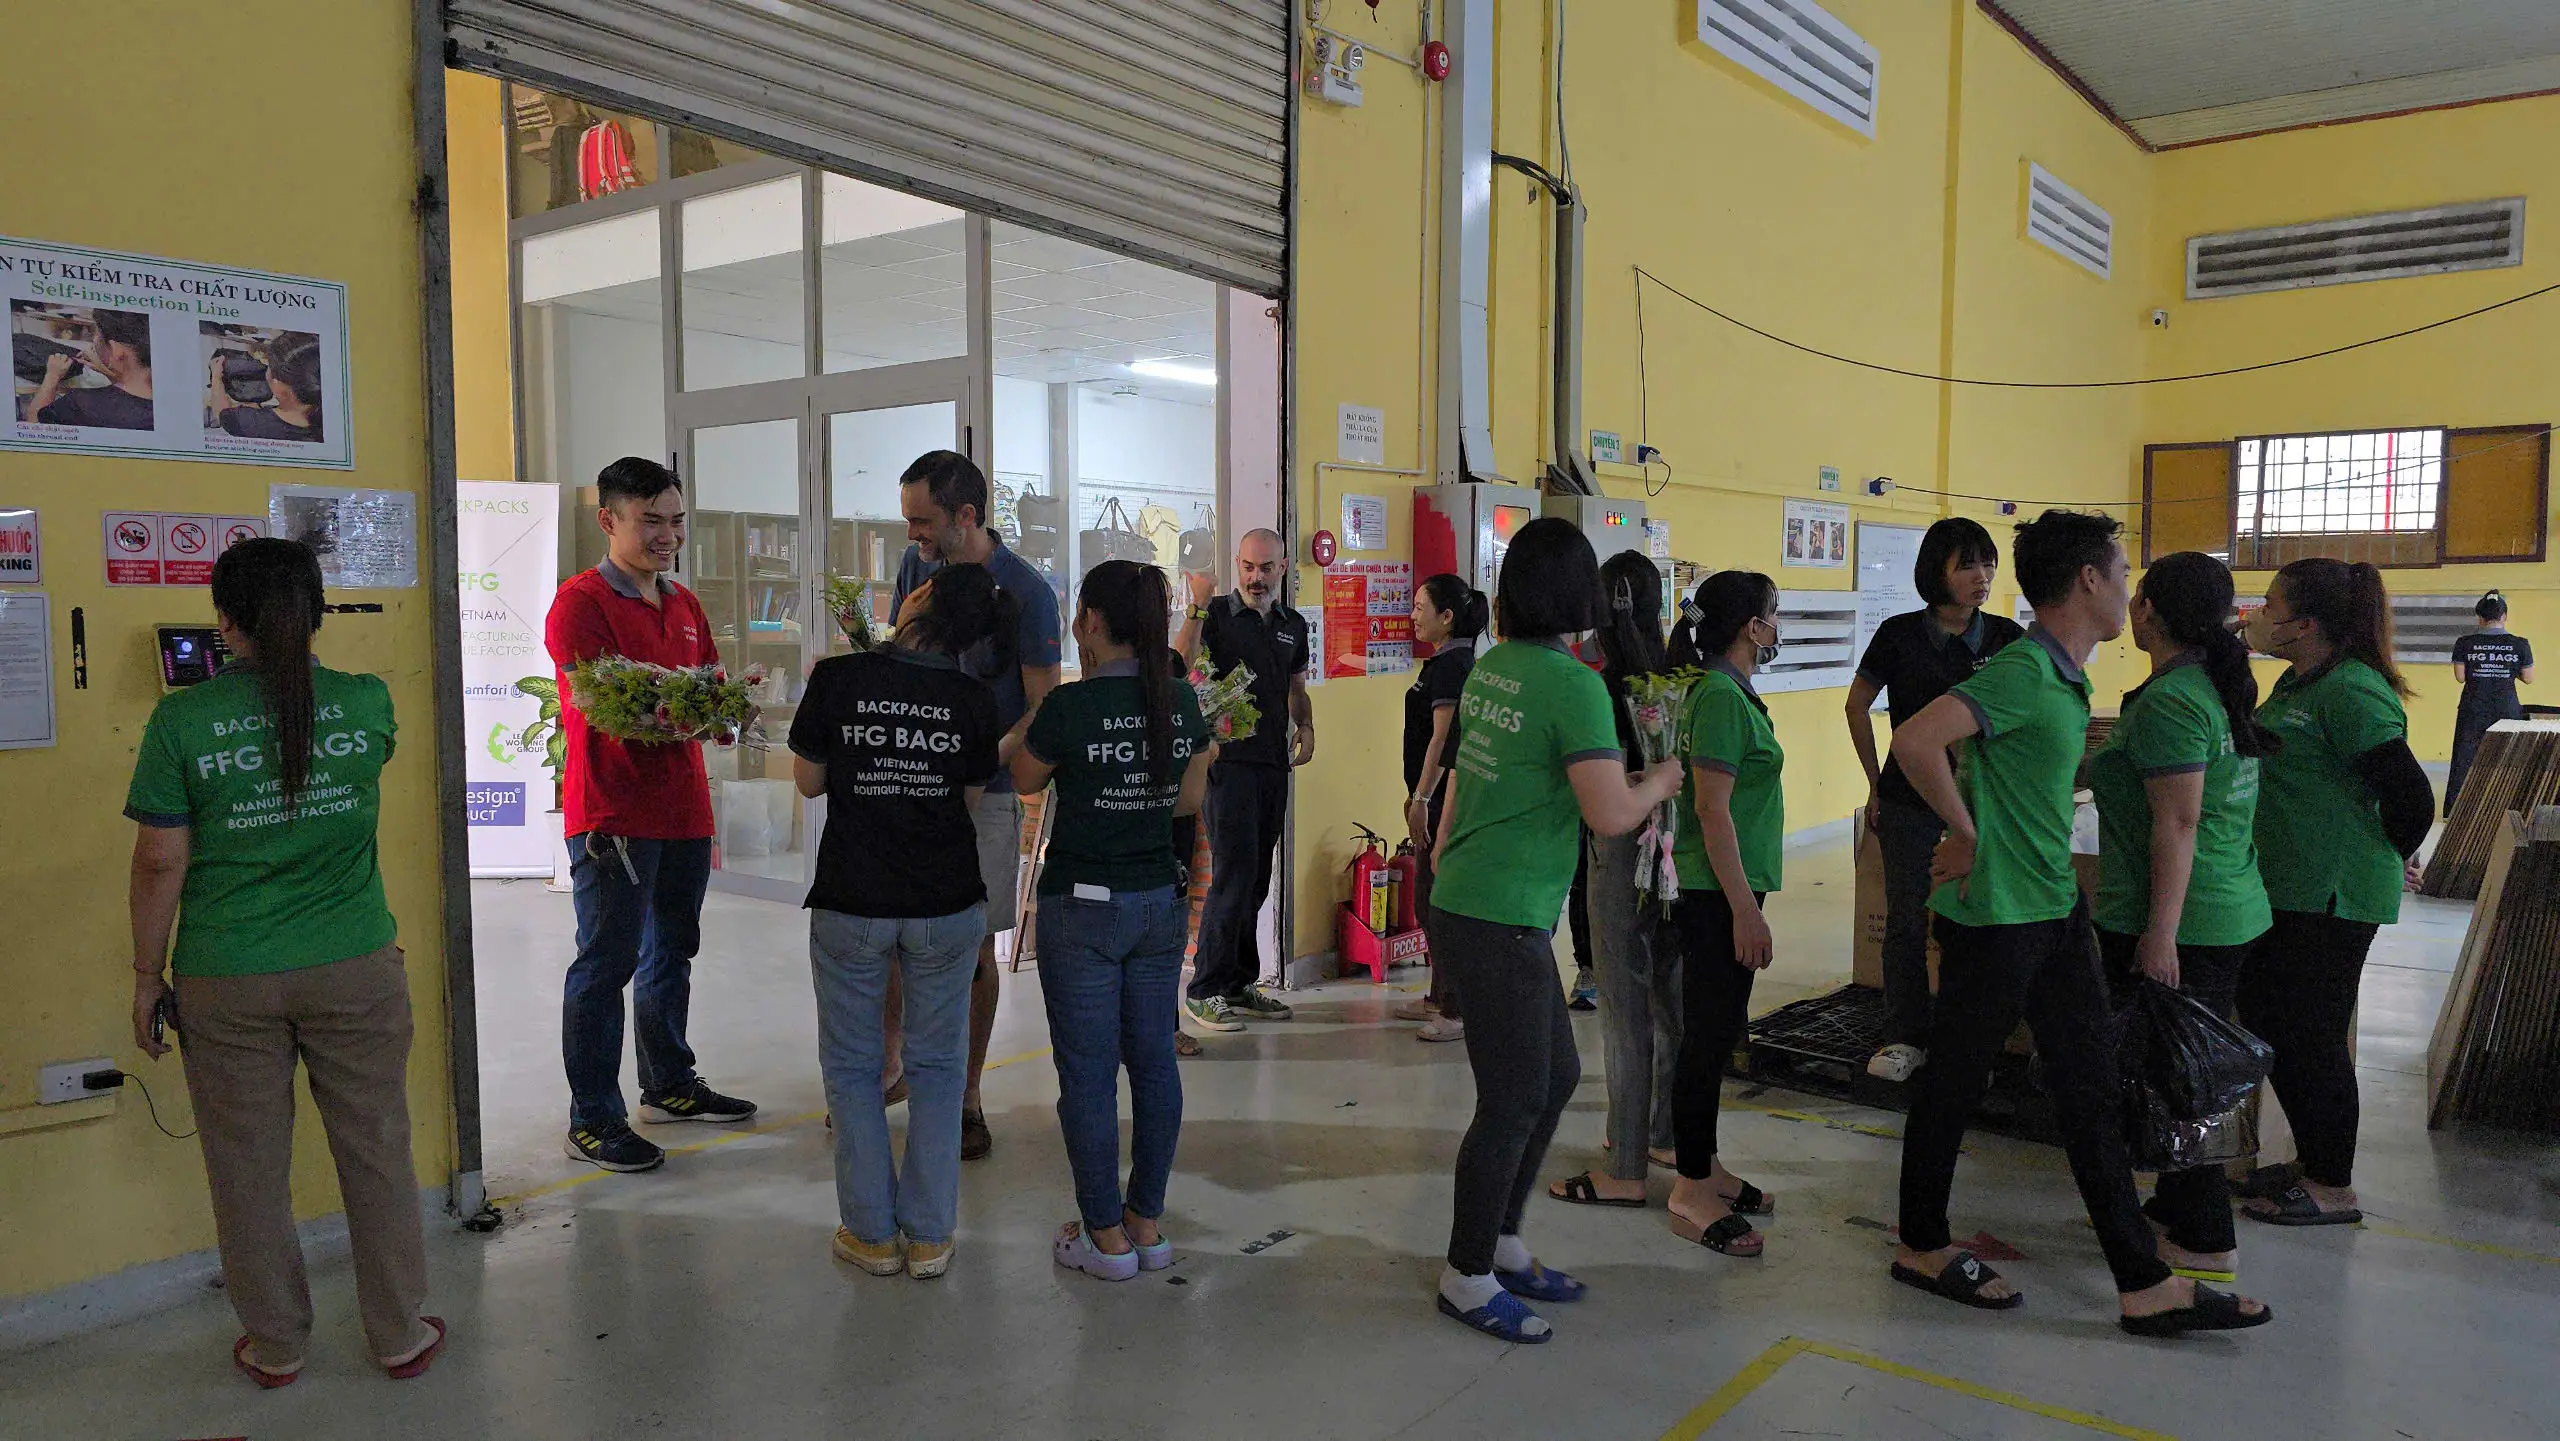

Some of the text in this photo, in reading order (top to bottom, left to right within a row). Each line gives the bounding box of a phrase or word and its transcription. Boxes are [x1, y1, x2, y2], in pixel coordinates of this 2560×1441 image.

[20, 258, 55, 280] TỰ
[61, 259, 123, 285] KIỂM
[128, 272, 174, 291] TRA
[180, 278, 239, 299] CHẤT
[245, 288, 317, 310] LƯỢNG
[31, 279, 240, 318] Self-inspection Line
[480, 645, 537, 656] FACTORY
[2467, 653, 2519, 662] FFG BAGS
[464, 684, 507, 695] amfori
[857, 700, 951, 721] BACKPACKS
[841, 725, 962, 753] FFG BAGS
[1087, 741, 1136, 763] FFG
[196, 745, 264, 780] FFG
[873, 757, 929, 771] VIETNAM
[856, 771, 944, 784] MANUFACTURING
[853, 785, 950, 797] BOUTIQUE FACTORY
[1094, 798, 1146, 811] BOUTIQUE
[227, 797, 360, 830] BOUTIQUE FACTORY
[467, 809, 498, 821] UCT
[1393, 936, 1418, 958] PCCC
